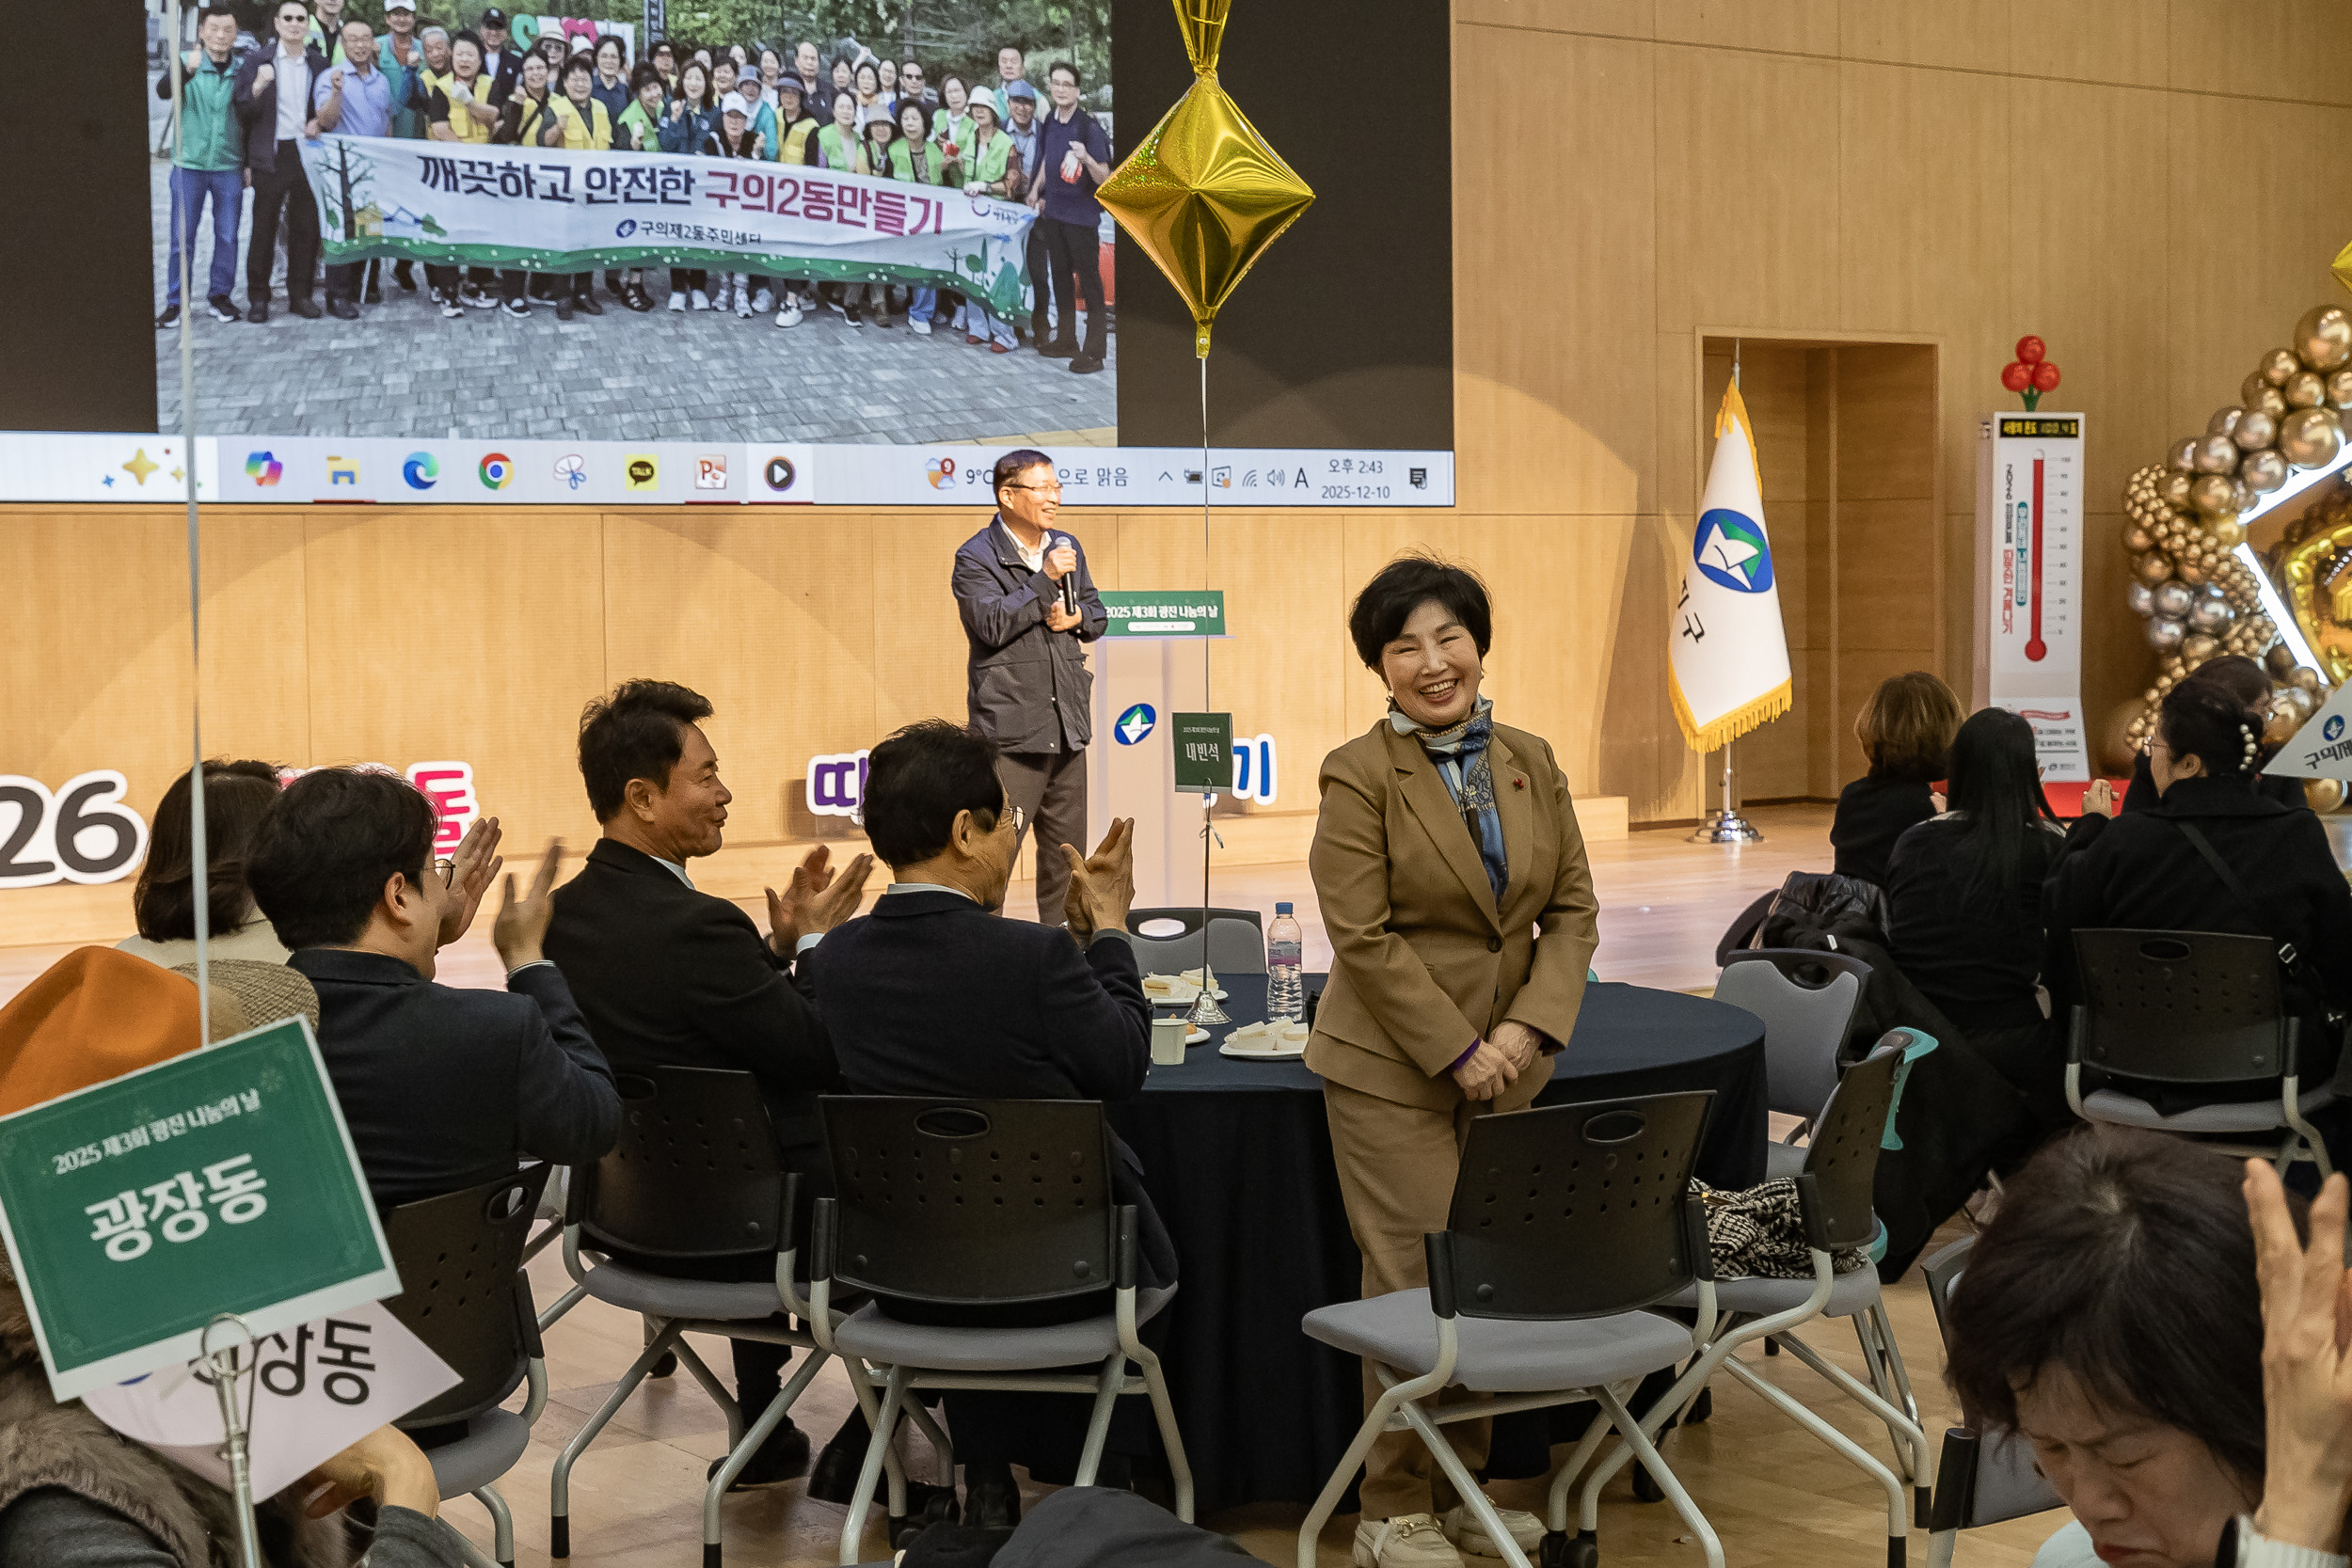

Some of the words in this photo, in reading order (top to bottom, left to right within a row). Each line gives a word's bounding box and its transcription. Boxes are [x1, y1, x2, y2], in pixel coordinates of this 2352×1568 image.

[417, 155, 576, 203] 깨끗하고
[585, 165, 696, 205] 안전한
[706, 170, 943, 237] 구의2동만들기
[1058, 468, 1089, 485] 으로
[1097, 467, 1129, 487] 맑음
[1328, 459, 1354, 473] 오후
[1359, 461, 1383, 474] 2:43
[1294, 467, 1310, 488] A
[1321, 485, 1391, 499] 2025-12-10
[1105, 606, 1131, 619] 2025
[1185, 742, 1220, 763] 내빈석
[52, 1143, 103, 1175] 2025
[186, 1095, 242, 1128] 나눔의
[240, 1088, 262, 1113] 날
[85, 1153, 268, 1262] 광장동
